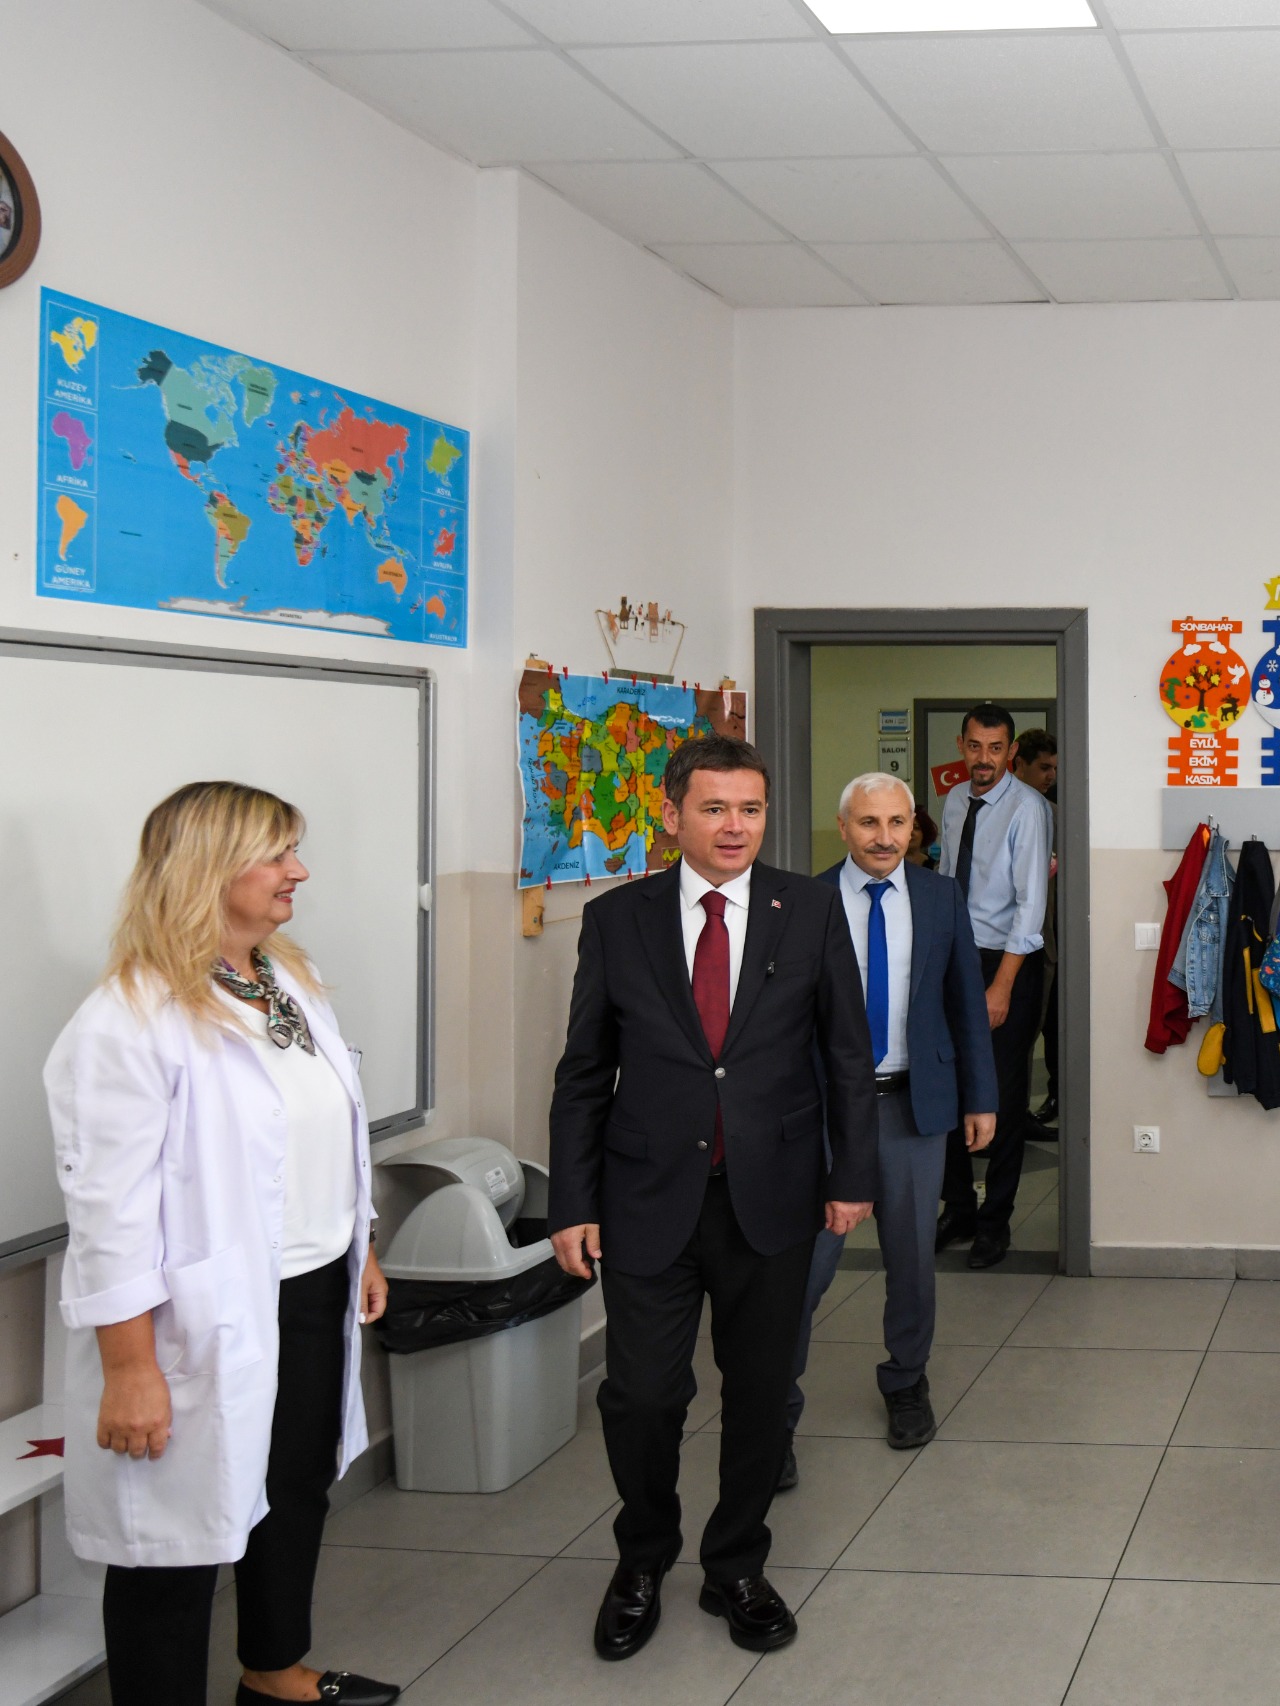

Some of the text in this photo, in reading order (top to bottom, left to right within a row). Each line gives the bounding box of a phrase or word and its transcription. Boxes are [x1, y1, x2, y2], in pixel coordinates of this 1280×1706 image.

[57, 378, 88, 393] KUZEY
[436, 487, 452, 497] ASYA
[55, 563, 86, 576] GÜNEY
[1179, 621, 1233, 633] SONBAHAR
[1189, 737, 1221, 750] EYLÜL
[890, 760, 899, 772] 9
[1189, 755, 1217, 767] EKİM
[1185, 775, 1220, 785] KASIM
